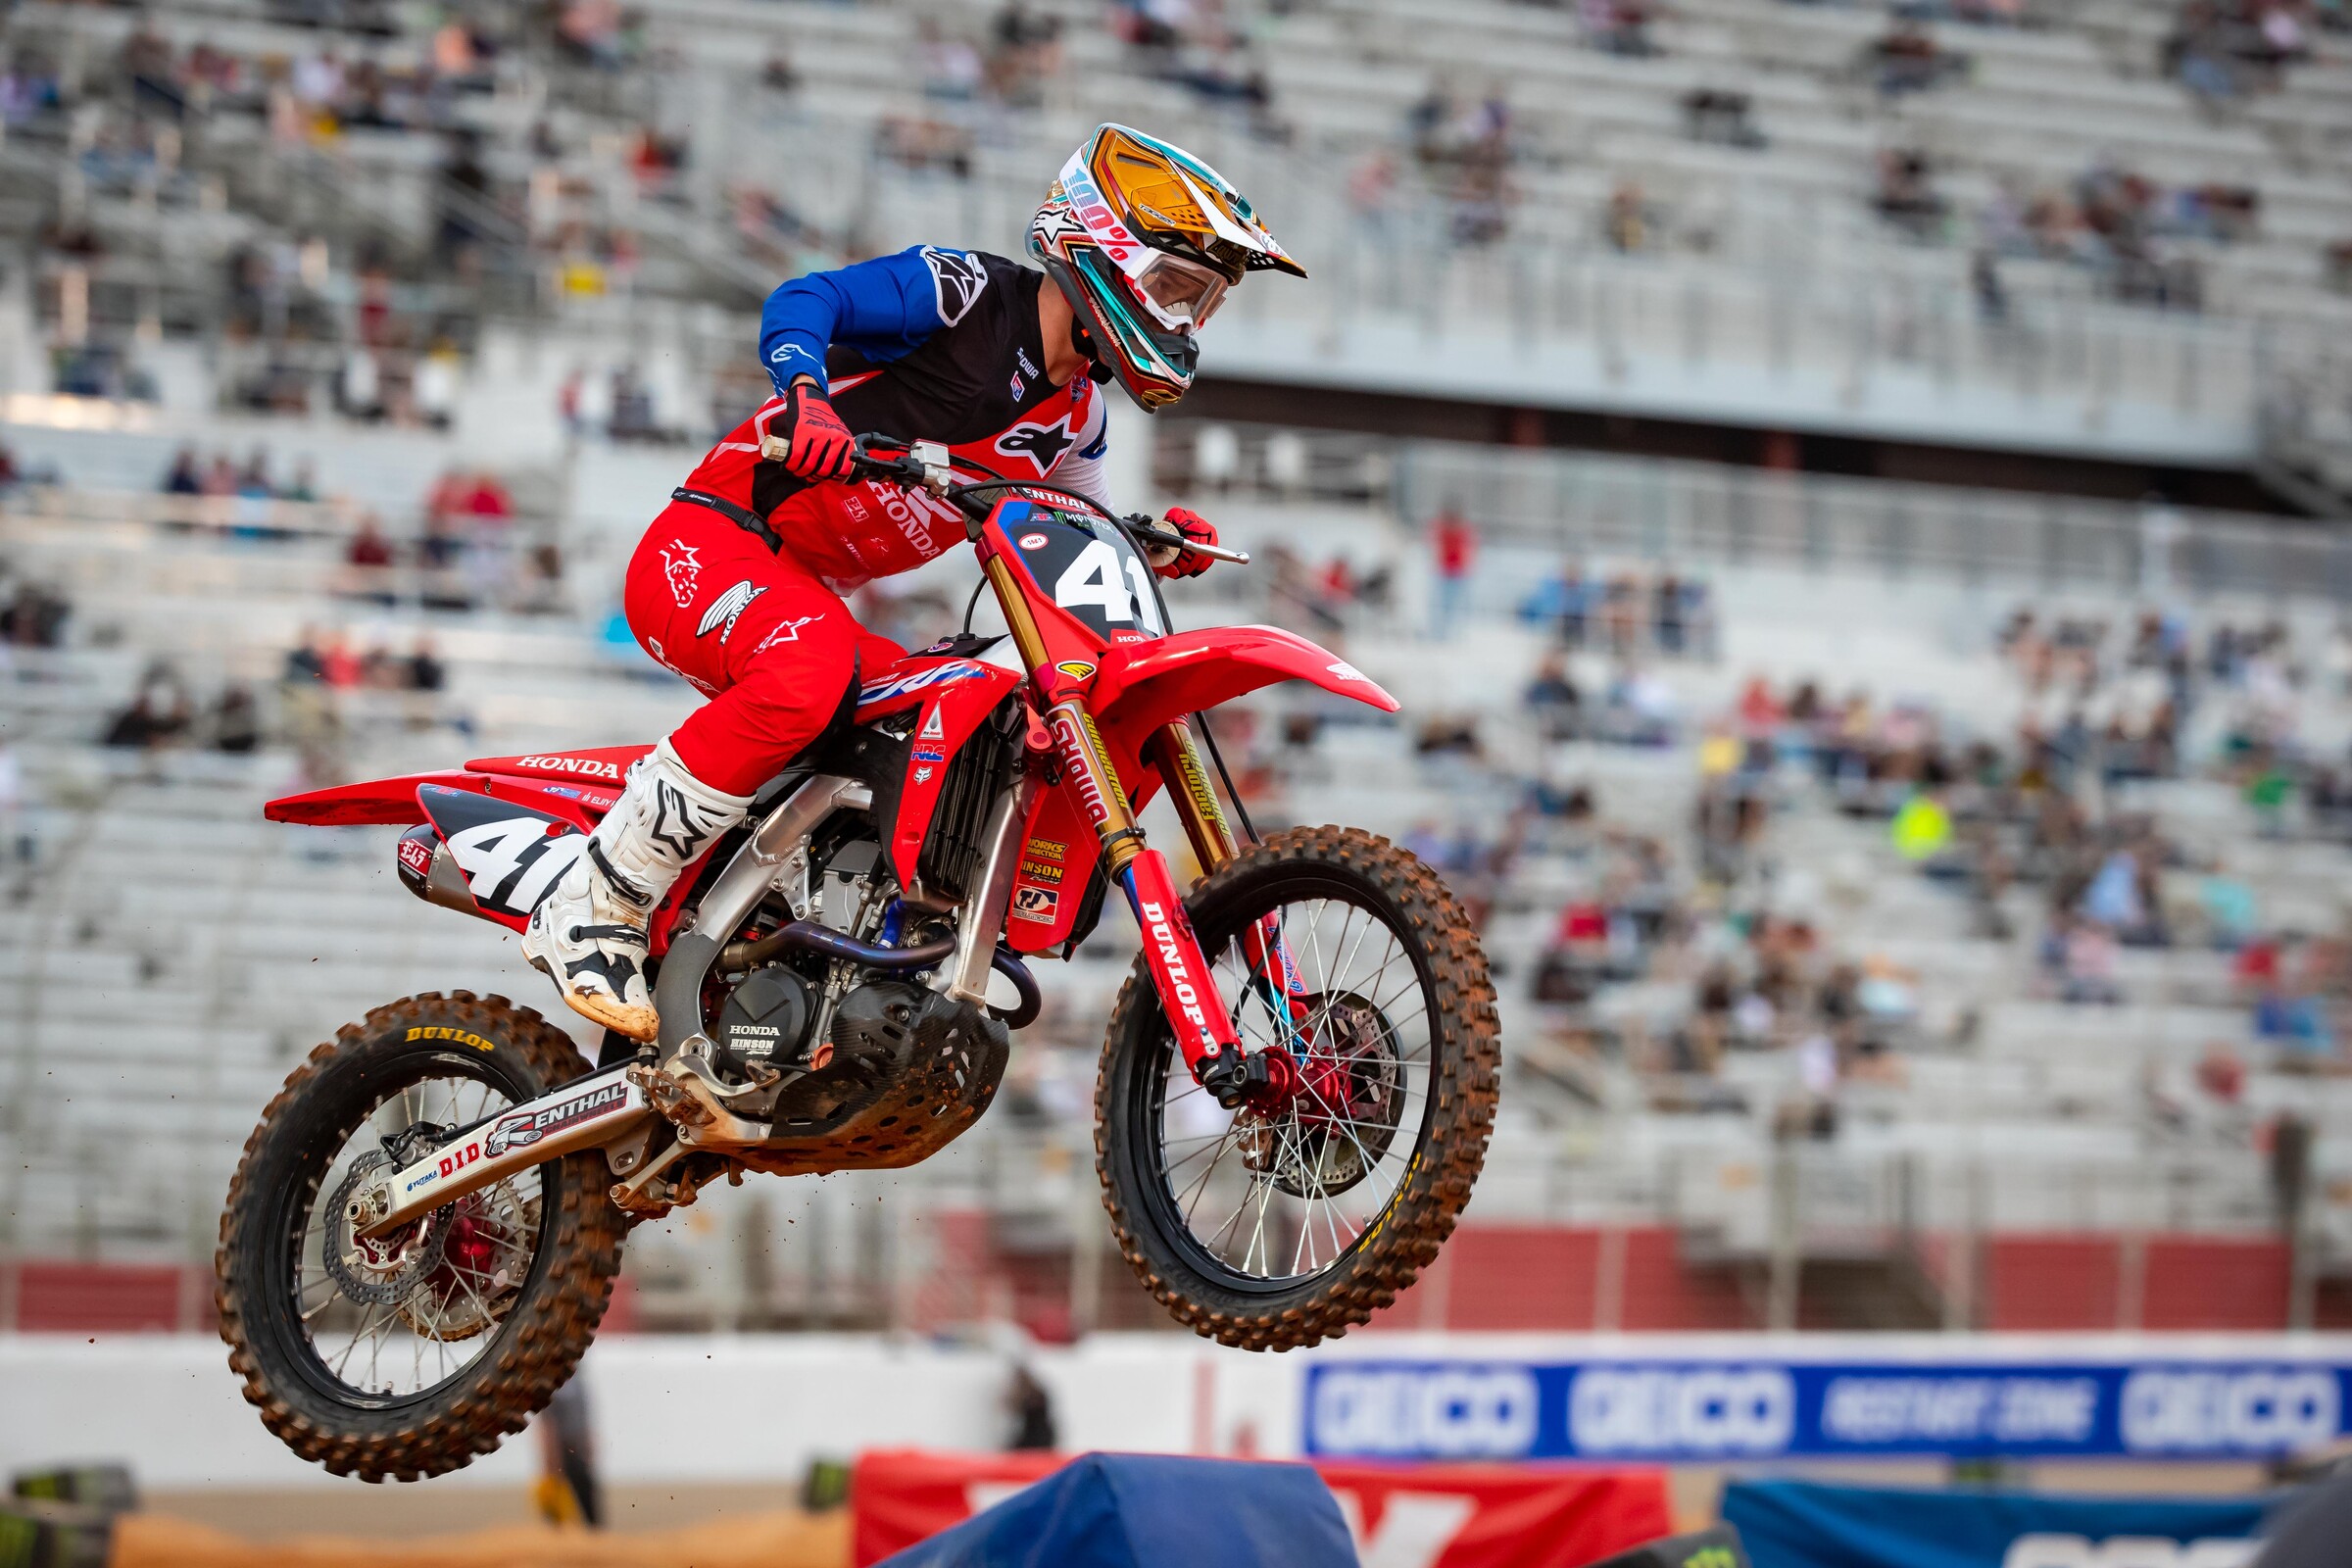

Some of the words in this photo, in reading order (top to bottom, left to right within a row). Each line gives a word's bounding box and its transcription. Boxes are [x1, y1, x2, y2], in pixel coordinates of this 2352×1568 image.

[1063, 168, 1140, 262] 100%
[866, 479, 941, 560] HONDA
[1055, 539, 1159, 637] 41
[911, 744, 946, 761] HRC
[516, 756, 619, 779] HONDA
[446, 817, 590, 913] 41
[1022, 860, 1063, 878] INSON
[1142, 902, 1205, 1026] DUNLOP
[404, 1026, 495, 1054] DUNLOP
[729, 1025, 780, 1036] HONDA
[730, 1039, 774, 1049] HINSON
[412, 1169, 438, 1189] YUTAKA
